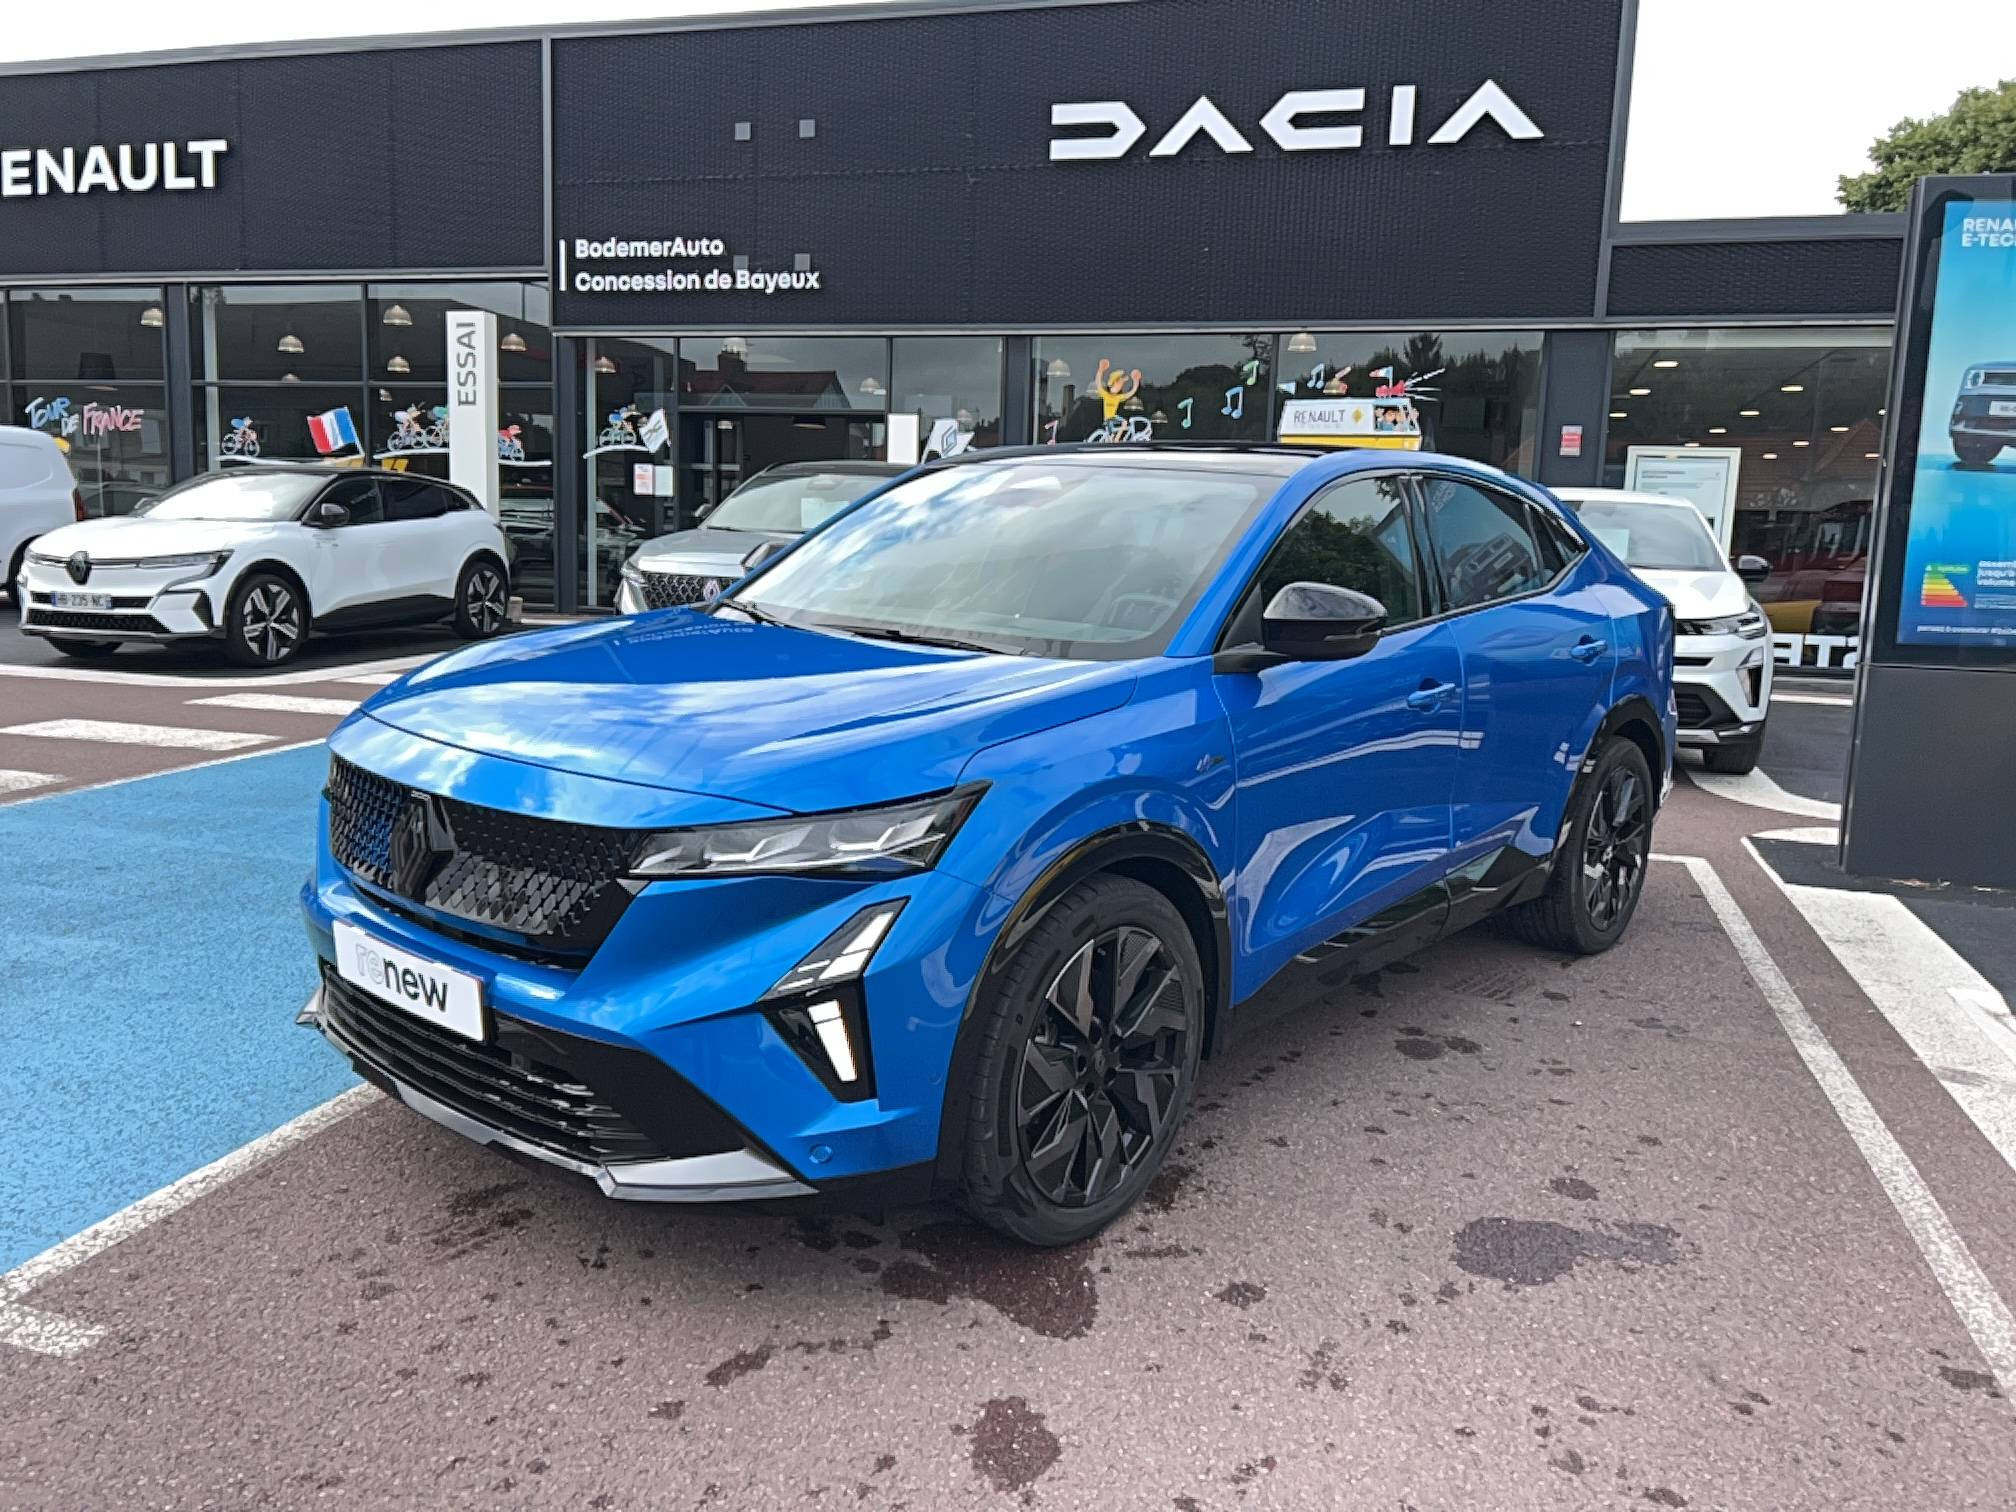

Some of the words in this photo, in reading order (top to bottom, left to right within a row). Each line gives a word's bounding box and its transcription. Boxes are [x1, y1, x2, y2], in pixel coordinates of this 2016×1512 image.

[1048, 78, 1545, 161] DACIA
[1, 138, 228, 198] ENAULT
[1963, 217, 2016, 232] RENA
[574, 237, 725, 259] BodemerAuto
[1961, 233, 2016, 248] E-TEC
[574, 268, 701, 292] Concession
[703, 269, 732, 291] de
[735, 268, 821, 294] Bayeux
[455, 321, 477, 407] ESSAI
[61, 413, 80, 438] DE
[83, 401, 145, 436] FRANCE
[1293, 408, 1346, 425] RENAULT
[354, 943, 448, 1013] renew
